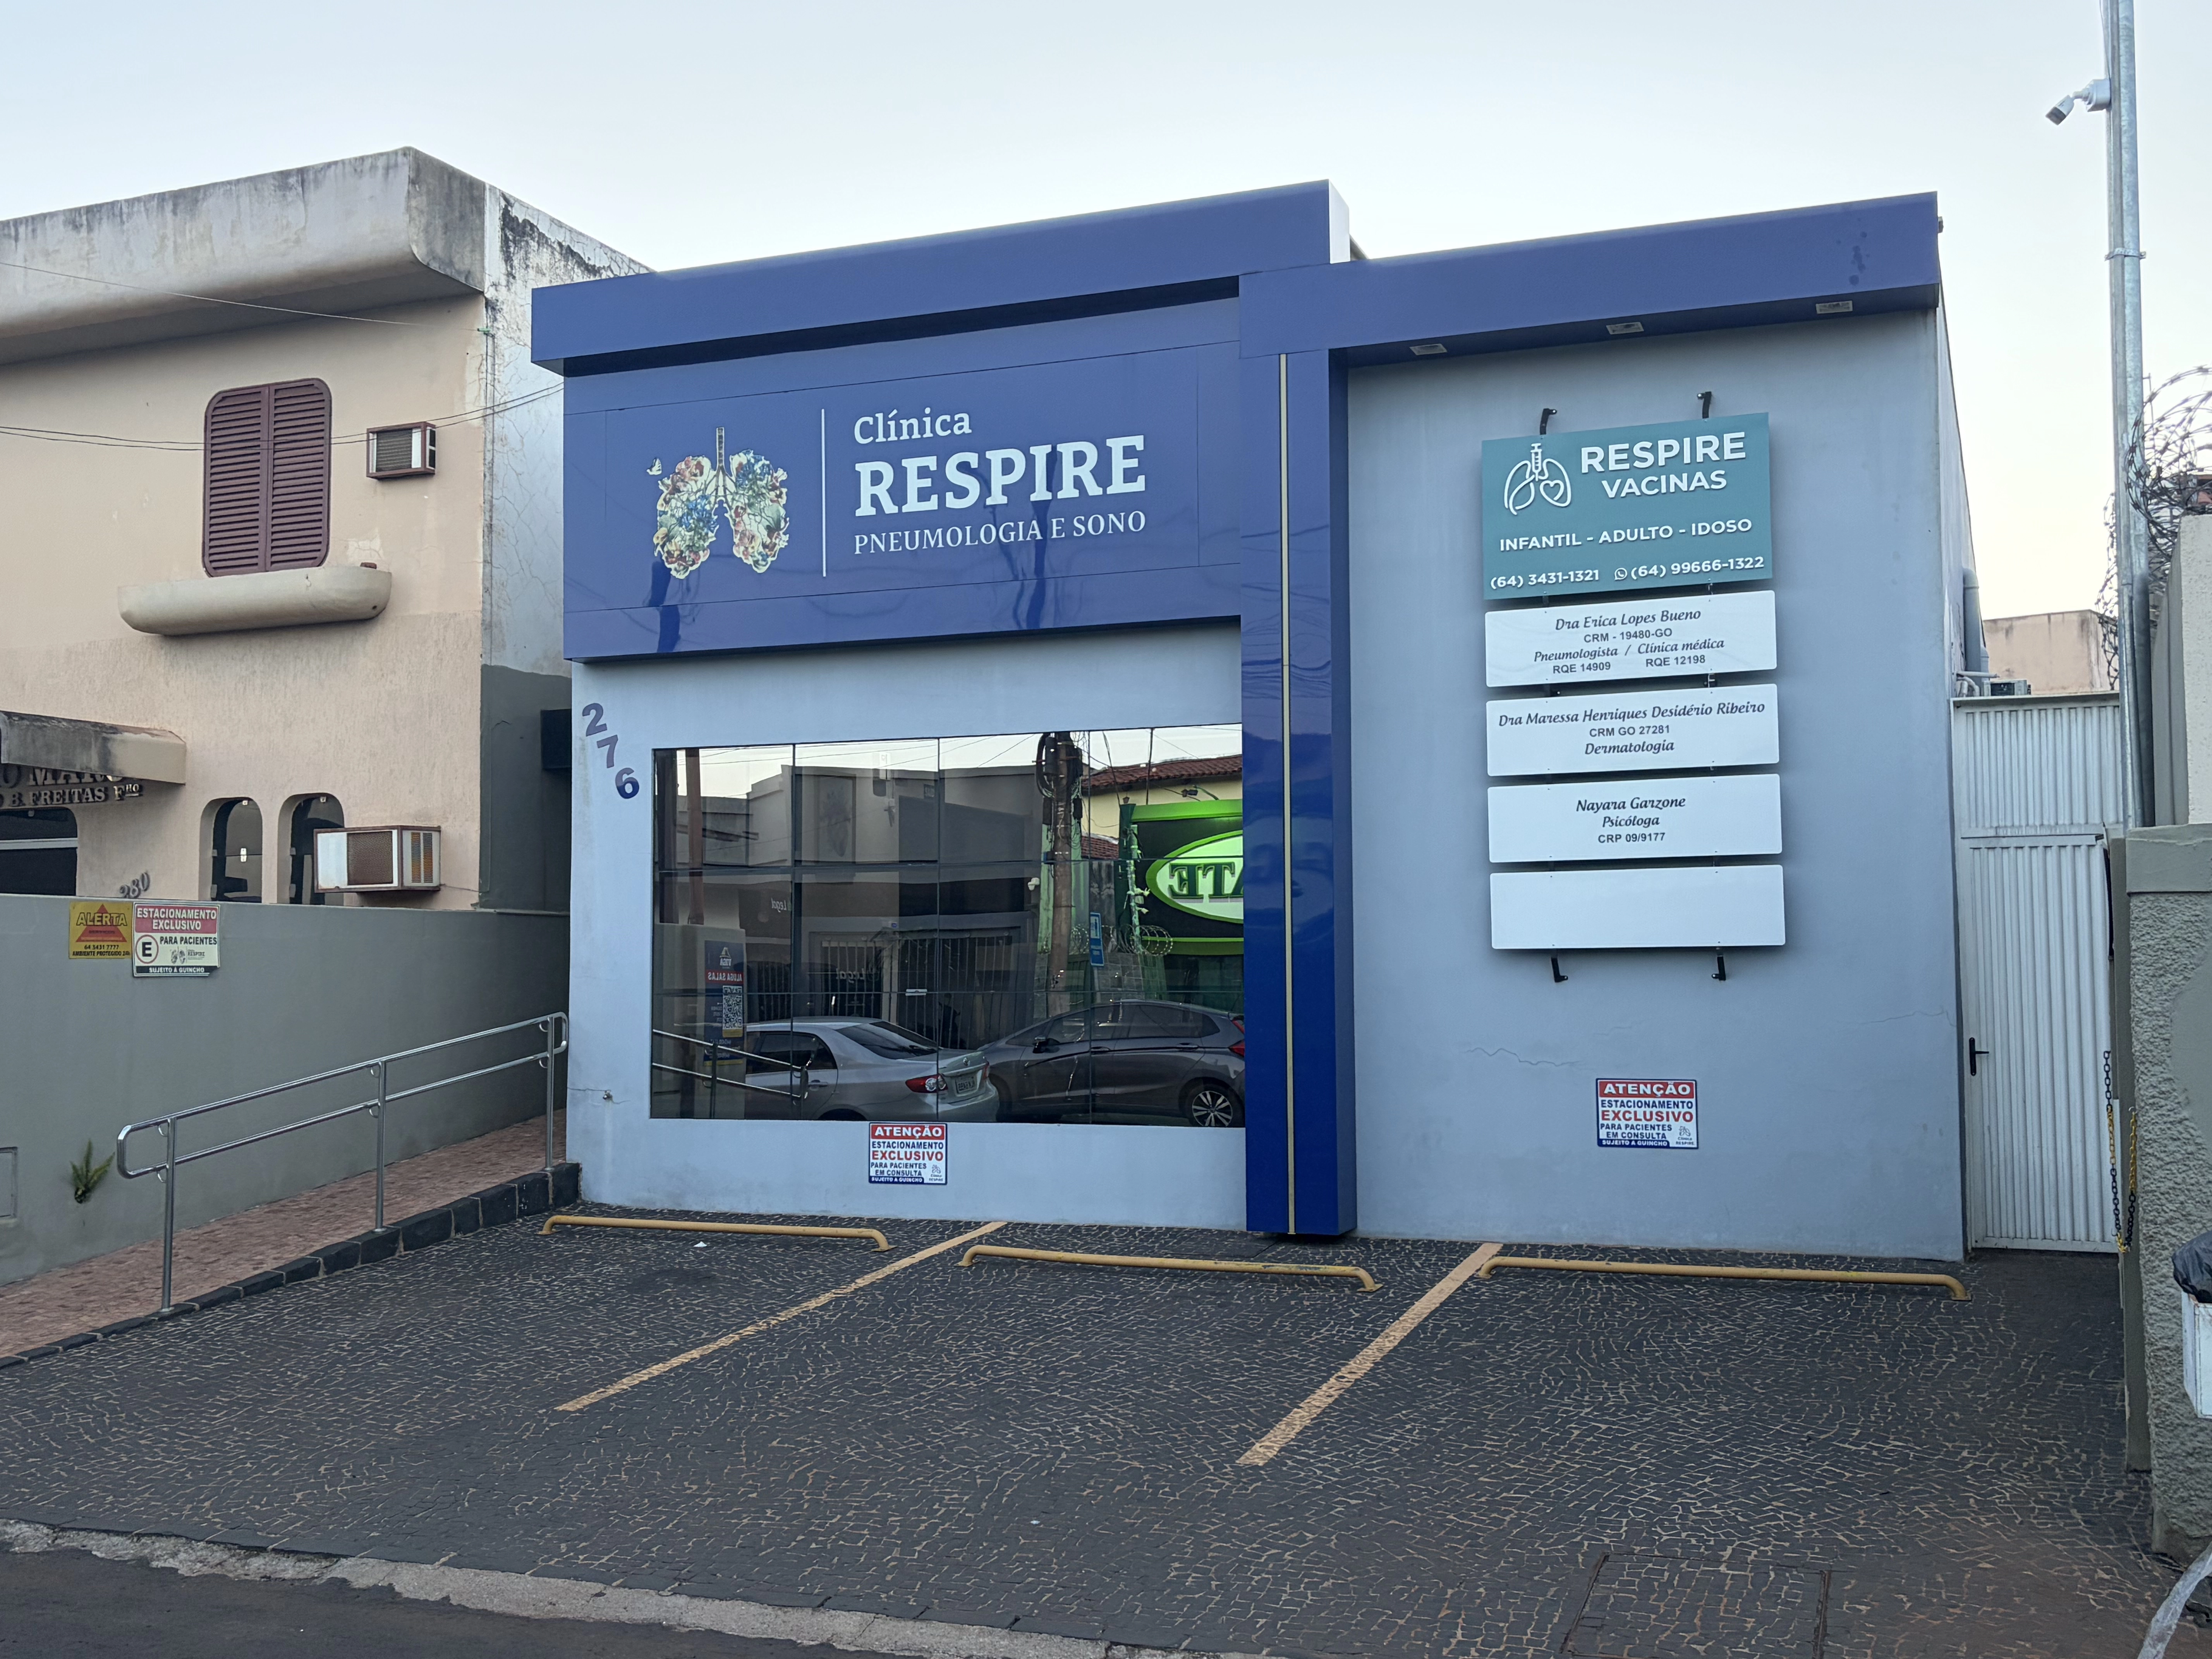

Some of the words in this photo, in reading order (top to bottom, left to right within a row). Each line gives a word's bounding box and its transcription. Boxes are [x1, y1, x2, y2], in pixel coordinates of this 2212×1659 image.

[854, 407, 972, 445] Clínica
[1581, 431, 1746, 474] RESPIRE
[855, 434, 1146, 517] RESPIRE
[1602, 470, 1727, 498] VACINAS
[854, 519, 1043, 555] PNEUMOLOGIA
[1051, 517, 1065, 539] E
[1073, 510, 1146, 537] SONO
[1500, 533, 1582, 551] INFANTIL
[1599, 525, 1673, 544] ADULTO
[1692, 519, 1752, 536] IDOSO
[1491, 573, 1524, 590] (64)
[1528, 569, 1600, 586] 3431-1321
[1631, 565, 1666, 580] (64)
[1671, 556, 1764, 574] 99666-1322
[1555, 618, 1580, 631] Dra
[1583, 616, 1618, 629] Erica
[1621, 613, 1656, 628] Lopes
[1660, 610, 1701, 622] Bueno
[1584, 633, 1609, 643] CRM
[1620, 628, 1673, 641] 19480-GO
[1534, 647, 1618, 663] Pneumologista
[1624, 644, 1631, 656] /
[1637, 642, 1679, 654] Clínica
[1681, 638, 1725, 651] médica
[1553, 664, 1577, 675] RQE
[1580, 661, 1611, 672] 14909
[1645, 658, 1671, 668] RQE
[1674, 654, 1706, 665] 12198
[1498, 714, 1523, 727] Dra
[1525, 713, 1579, 725] Maressa
[1582, 709, 1647, 723] Henriques
[1651, 704, 1713, 718] Desidério
[1716, 702, 1765, 715] Ribeiro
[1589, 727, 1614, 738] CRM
[1618, 726, 1635, 736] GO
[1638, 725, 1670, 735] 27281
[582, 702, 640, 799] 276
[1585, 740, 1675, 756] Dermatologia
[29, 787, 106, 806] FREITAS
[1576, 799, 1626, 814] Nayara
[1630, 797, 1686, 810] Garzone
[1602, 815, 1660, 828] Psicóloga
[1598, 833, 1622, 843] CRP
[1625, 832, 1666, 843] 09/9177
[76, 912, 128, 926] ALERTA
[137, 908, 216, 920] ESTACIONAMENTO
[152, 919, 202, 930] EXCLUSIVO
[160, 936, 178, 945] PARA
[180, 937, 217, 945] PACIENTES
[142, 942, 152, 957] E
[1604, 1081, 1691, 1097] ATENÇÃO
[1601, 1099, 1693, 1109] ESTACIONAMENTO
[1601, 1110, 1693, 1123] EXCLUSIVO
[874, 1125, 943, 1139] ATENÇÃO
[872, 1150, 944, 1161] EXCLUSIVO
